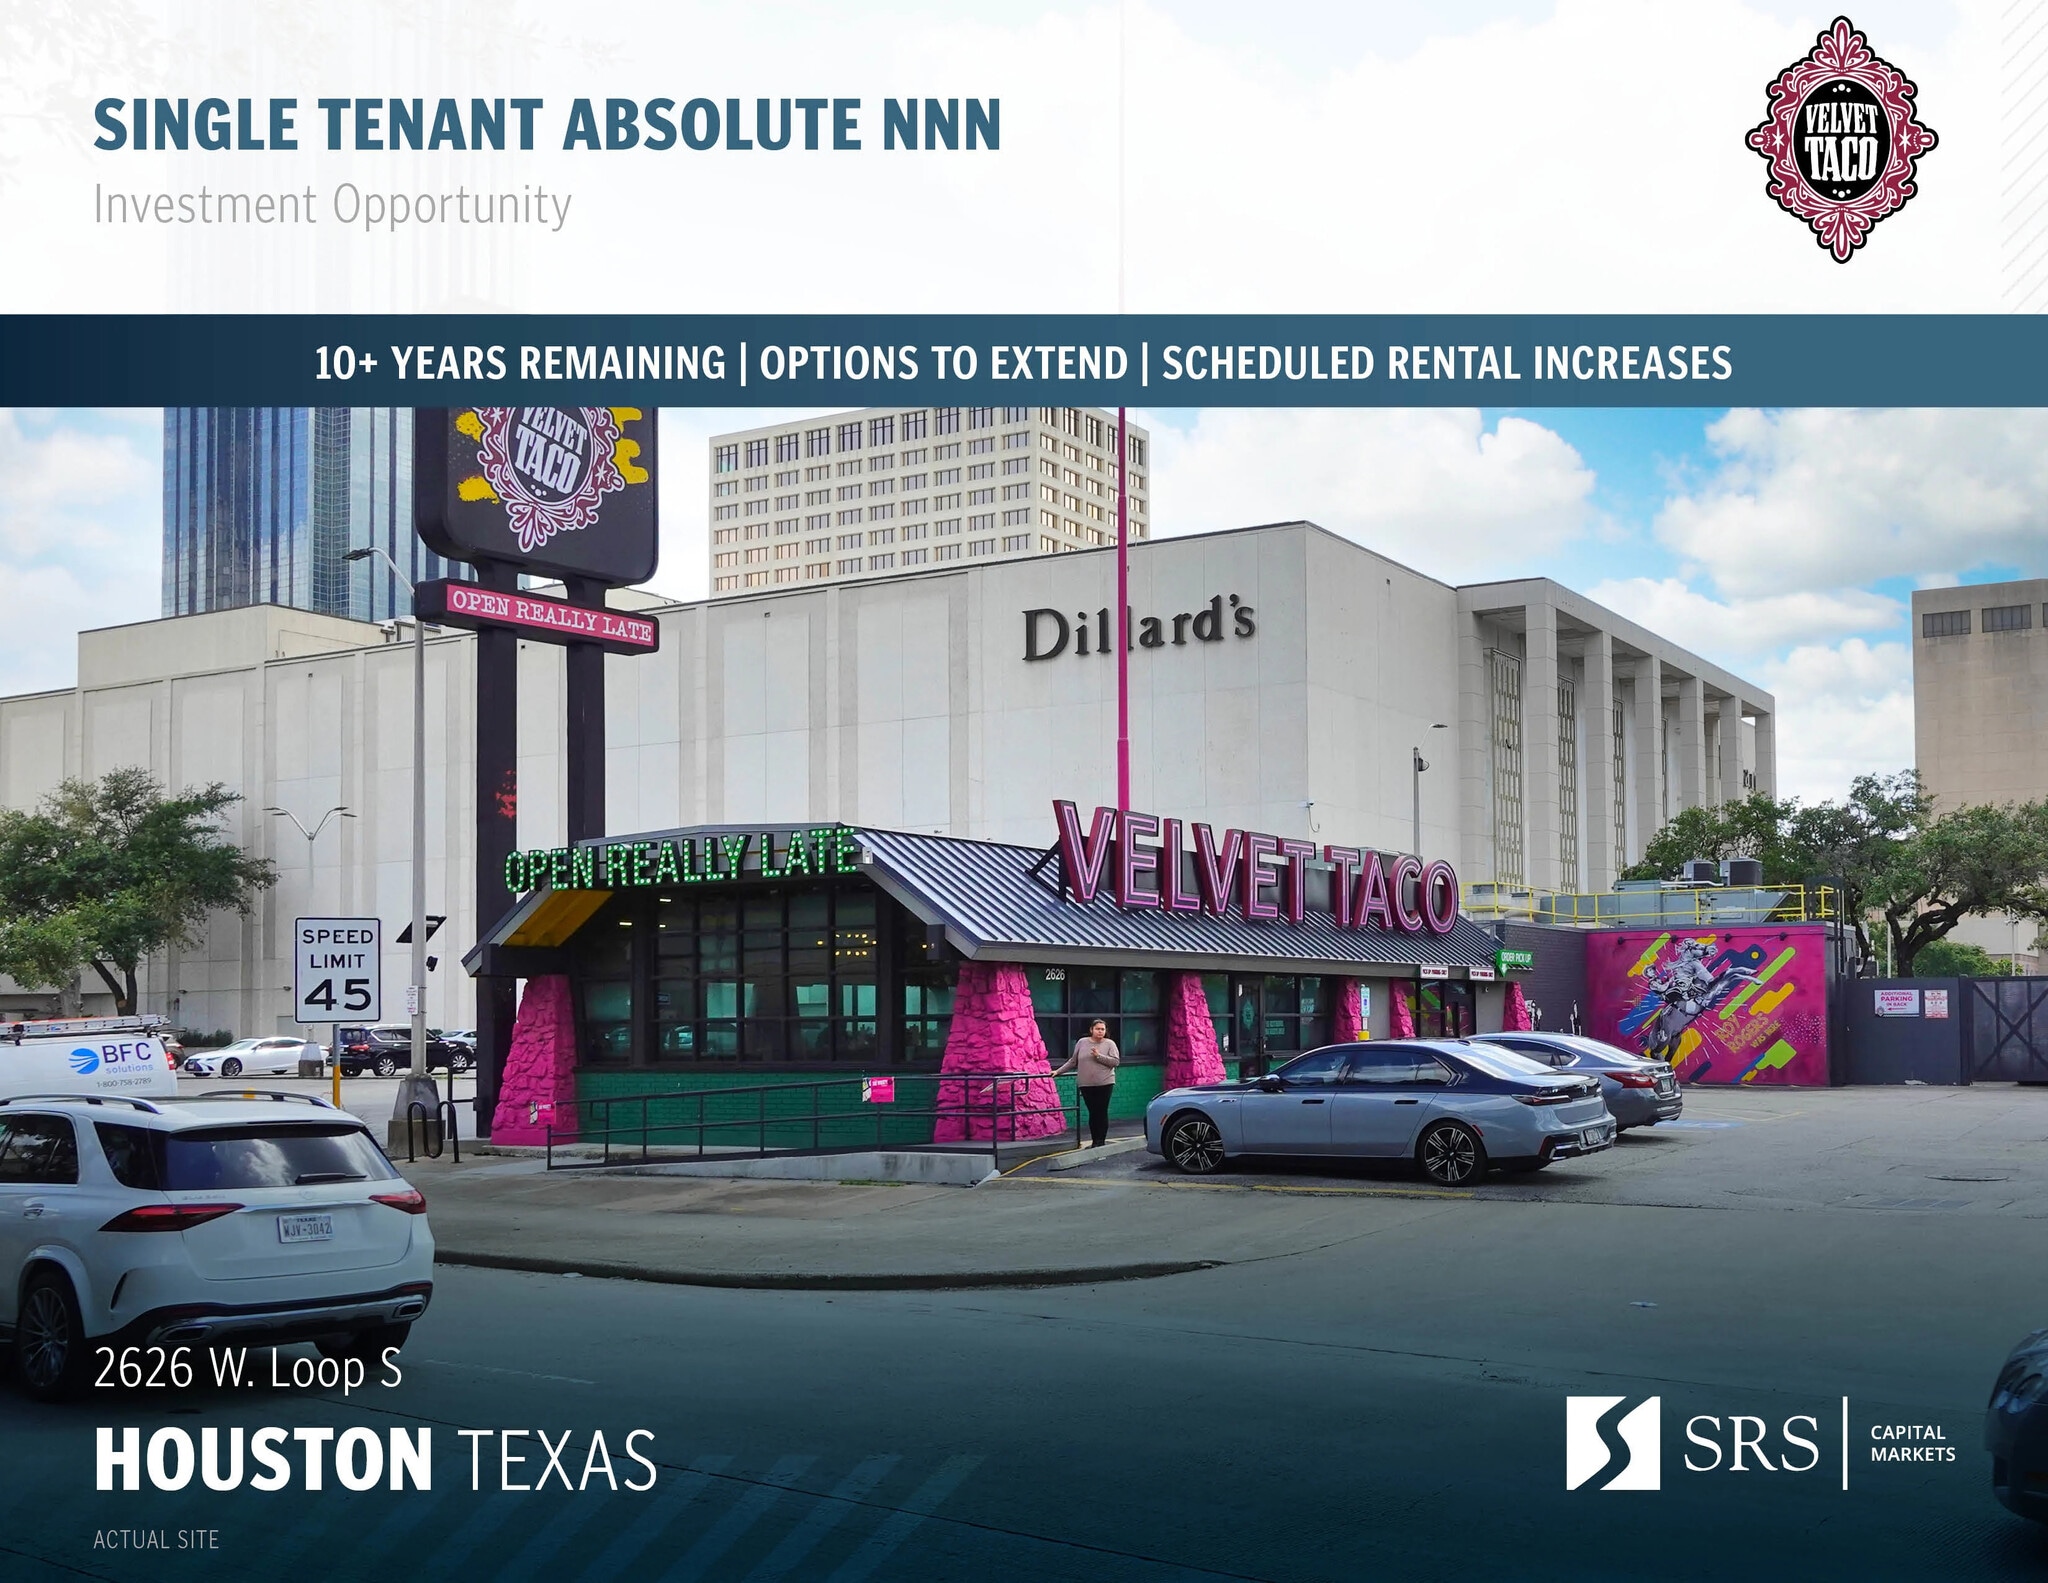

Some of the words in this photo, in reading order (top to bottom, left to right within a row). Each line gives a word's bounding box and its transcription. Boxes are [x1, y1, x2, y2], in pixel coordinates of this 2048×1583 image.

[515, 423, 581, 494] TACO
[453, 590, 510, 617] OPEN
[516, 600, 597, 631] REALLY
[602, 616, 652, 642] LATE
[504, 846, 594, 893] OPEN
[607, 834, 751, 887] REALLY
[761, 827, 860, 878] LATE
[1053, 799, 1316, 925] VELVET
[1324, 844, 1460, 935] TACO
[302, 929, 374, 944] SPEED
[310, 953, 366, 969] LIMIT
[1045, 968, 1066, 981] 2626
[304, 978, 372, 1011] 45
[102, 1042, 151, 1063] BFC
[105, 1063, 154, 1075] solutions
